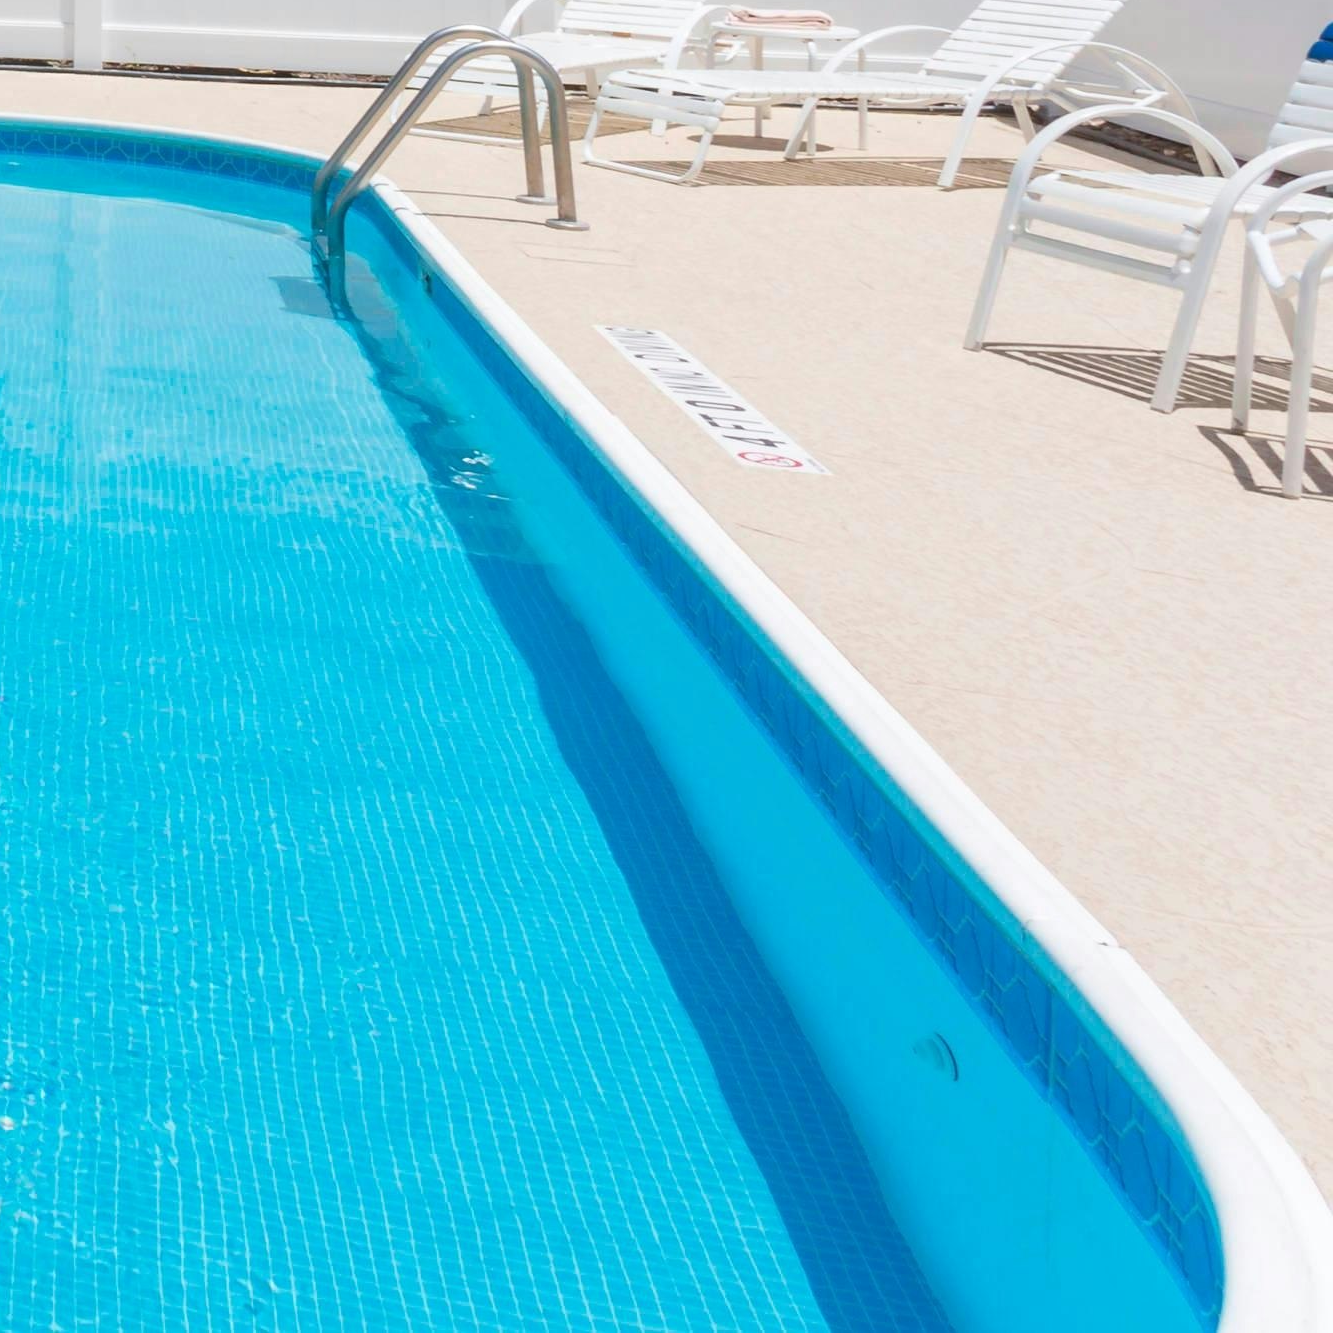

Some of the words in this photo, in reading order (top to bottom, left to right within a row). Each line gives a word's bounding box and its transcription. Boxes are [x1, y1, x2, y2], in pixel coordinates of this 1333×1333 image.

[605, 327, 690, 363] DIVING
[650, 368, 706, 381] NO
[698, 413, 773, 433] FT
[722, 435, 786, 448] 4
